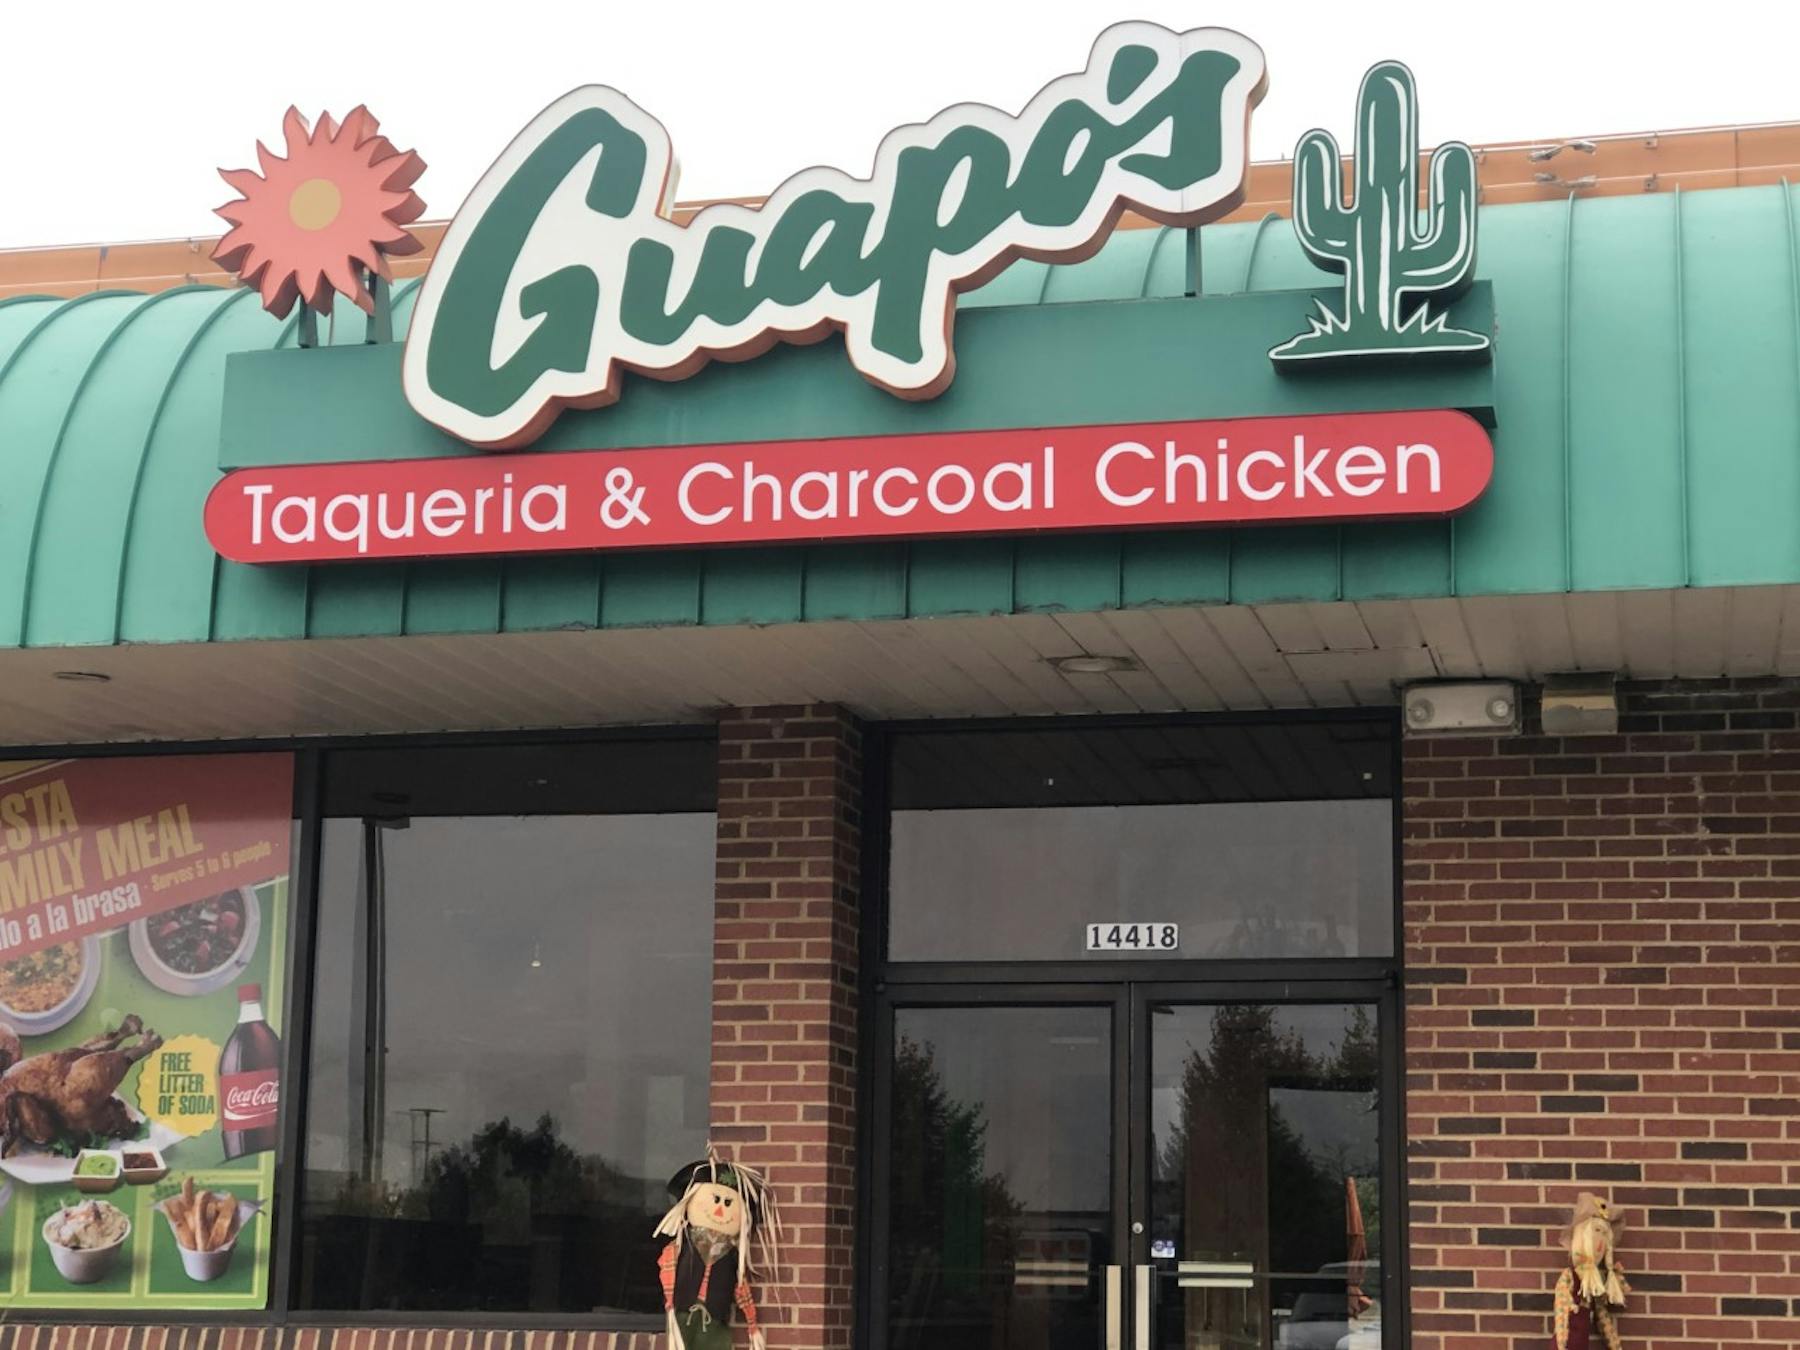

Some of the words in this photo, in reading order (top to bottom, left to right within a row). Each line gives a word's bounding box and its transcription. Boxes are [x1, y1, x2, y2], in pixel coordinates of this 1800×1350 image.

[426, 43, 1242, 418] Guapo's
[243, 473, 567, 553] Taqueria
[600, 466, 651, 530] &
[677, 446, 1055, 526] Charcoal
[1095, 434, 1441, 507] Chicken
[0, 837, 85, 914] MILY
[96, 803, 204, 881] MEAL
[152, 866, 194, 892] Serves
[195, 859, 206, 878] 5
[207, 857, 220, 874] to
[233, 841, 272, 869] people
[27, 913, 43, 940] a
[46, 902, 70, 934] la
[72, 882, 142, 926] brasa
[1091, 925, 1176, 948] 14418
[160, 1052, 192, 1072] FREE
[160, 1073, 205, 1094] LITTER
[158, 1094, 175, 1116] OF
[179, 1094, 215, 1115] SODA
